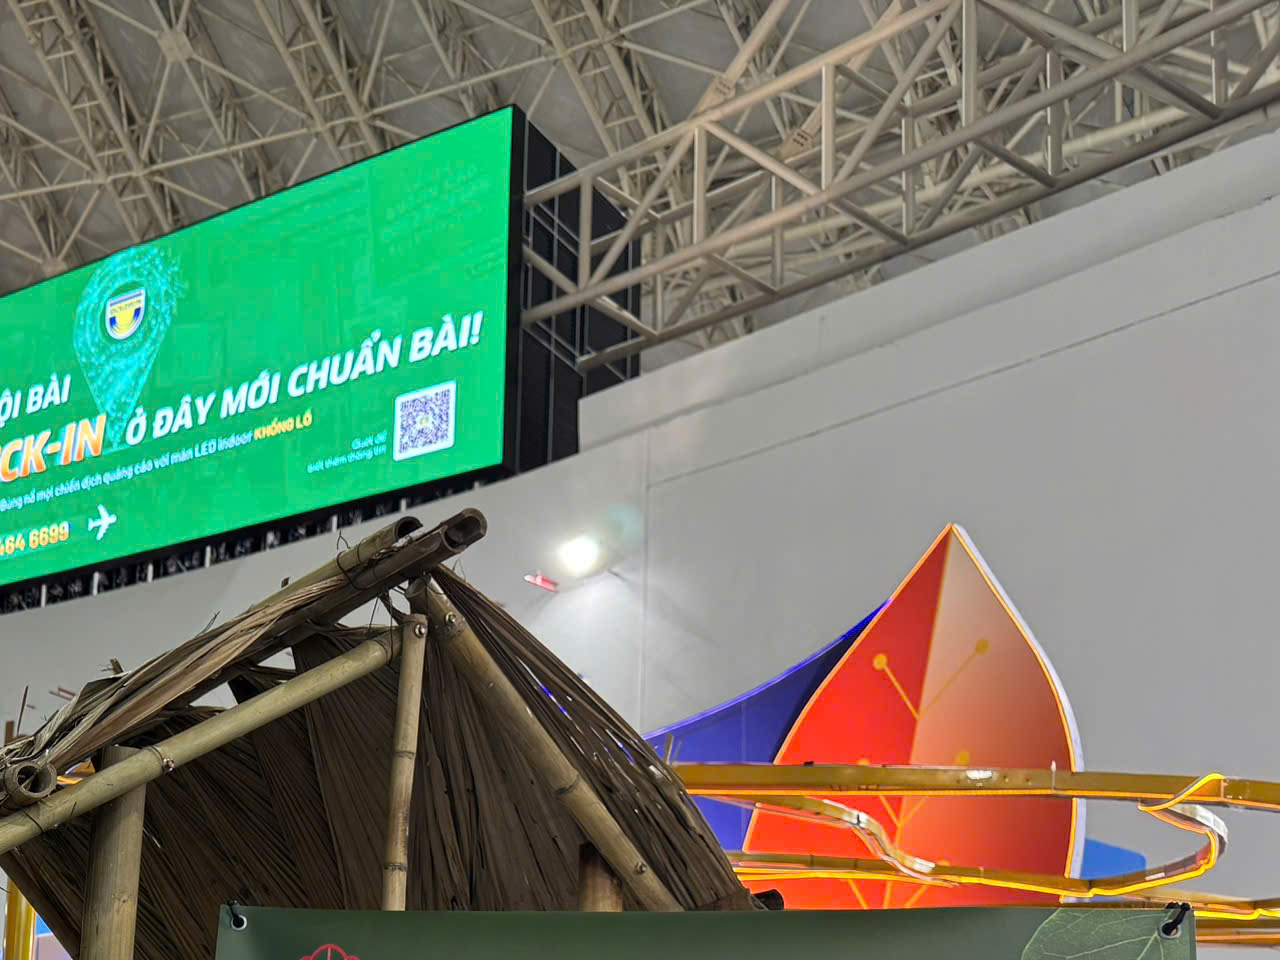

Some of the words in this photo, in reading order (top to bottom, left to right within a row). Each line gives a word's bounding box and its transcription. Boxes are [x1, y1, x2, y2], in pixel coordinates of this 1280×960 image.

[26, 373, 72, 414] BÀI
[125, 405, 147, 446] Ở
[152, 392, 217, 440] ĐÂY
[220, 369, 281, 420] MỚI
[287, 328, 403, 398] CHUẨN
[408, 310, 484, 363] BÀI!
[194, 439, 217, 458] LED
[29, 520, 69, 549] 6699
